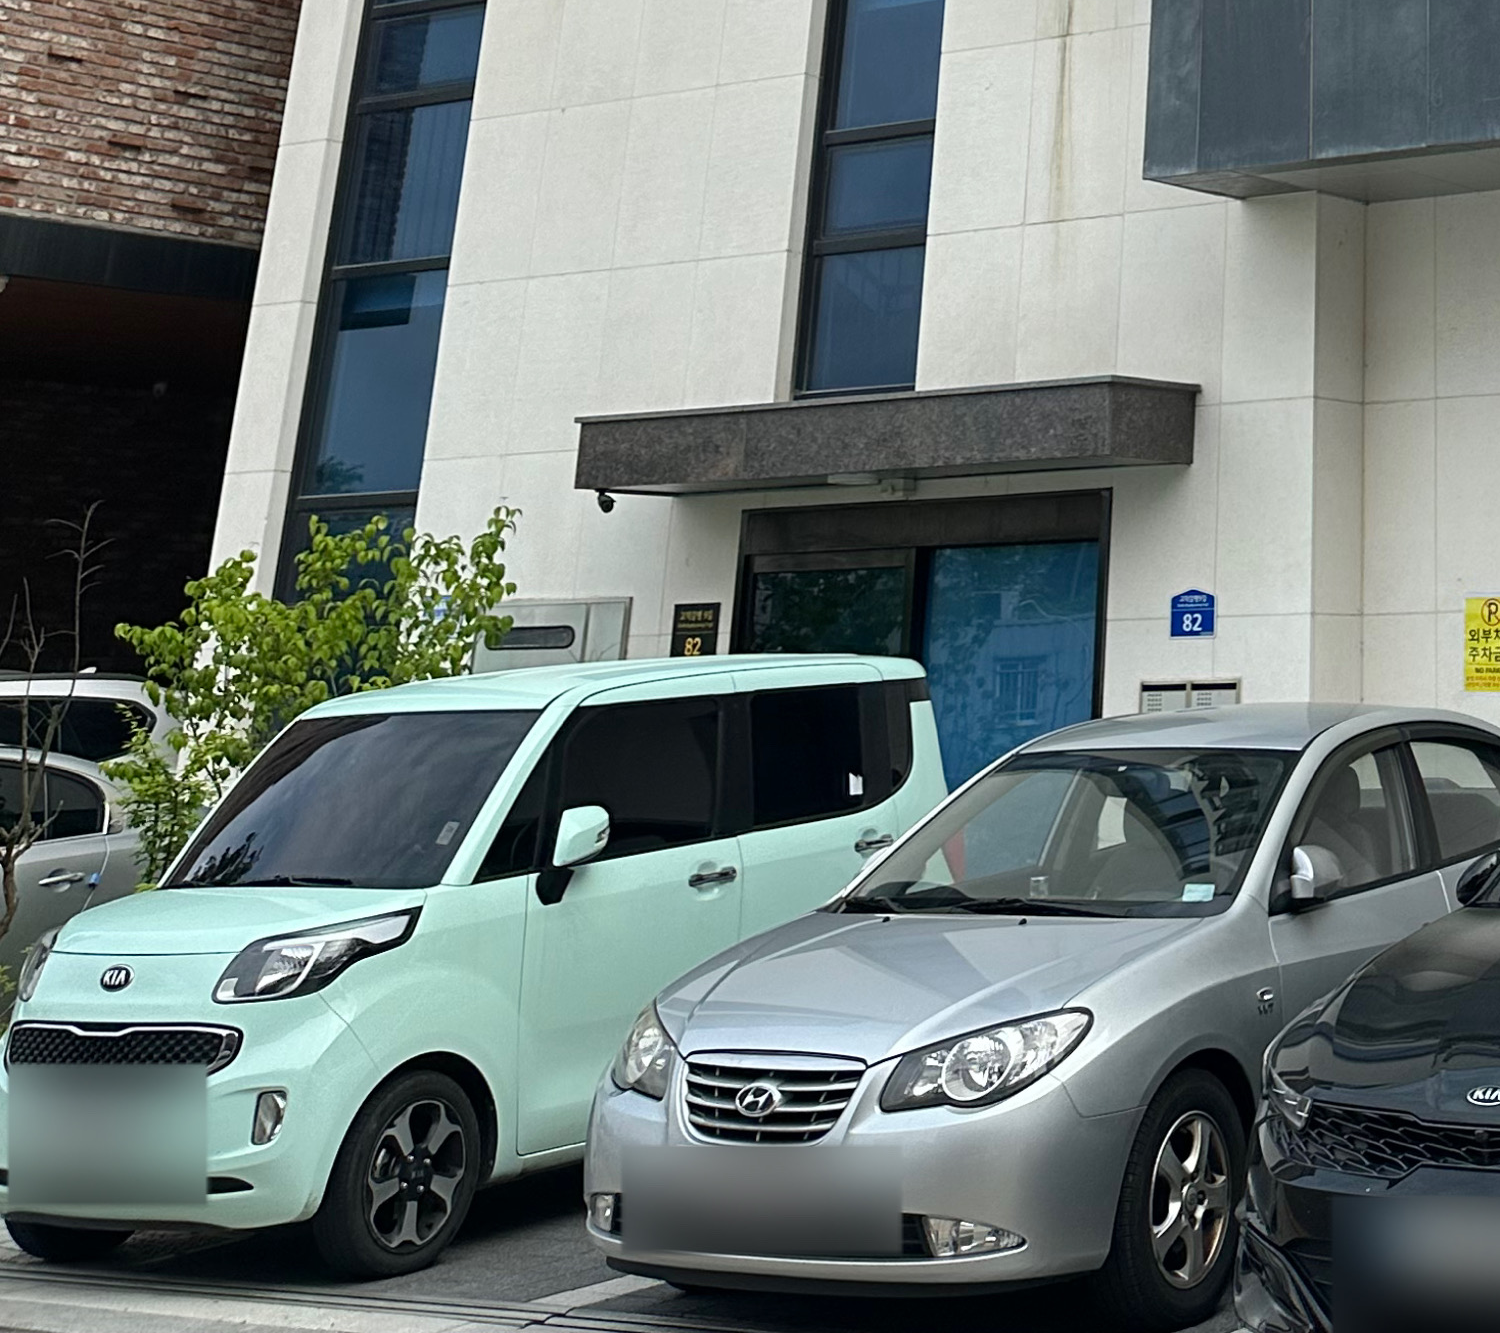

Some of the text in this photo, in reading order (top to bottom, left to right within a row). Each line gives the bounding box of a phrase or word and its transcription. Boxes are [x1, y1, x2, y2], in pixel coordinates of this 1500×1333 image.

[1182, 613, 1203, 632] 82
[684, 637, 702, 656] 82
[103, 969, 127, 986] KIA
